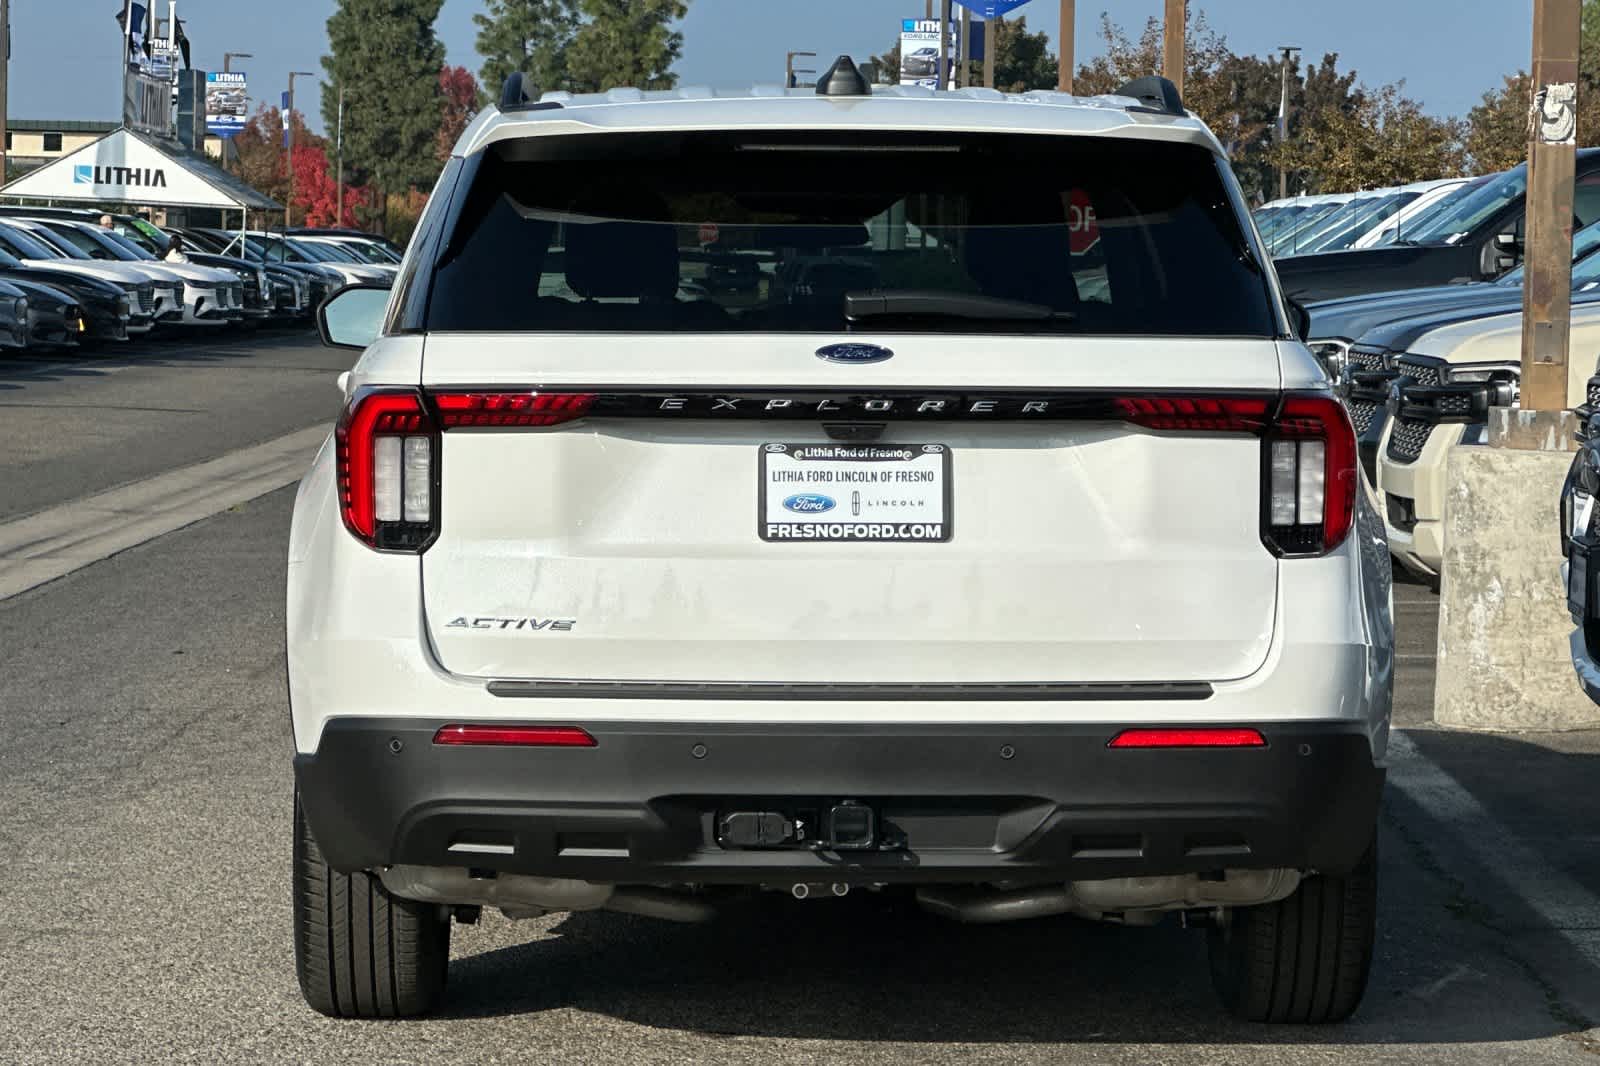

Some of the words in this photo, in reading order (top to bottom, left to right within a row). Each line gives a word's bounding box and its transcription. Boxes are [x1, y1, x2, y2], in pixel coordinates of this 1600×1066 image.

[914, 20, 941, 32] LITH
[215, 73, 245, 82] LITHIA
[94, 165, 167, 187] LITHIA
[659, 397, 1050, 414] EXPLORER
[805, 448, 833, 458] Lithia
[835, 447, 857, 458] Ford
[858, 448, 868, 458] of
[870, 448, 903, 458] Fresno
[772, 471, 804, 482] LITHIA
[807, 471, 833, 482] FORD
[835, 471, 877, 482] LINCOLN
[880, 471, 893, 482] OF
[896, 471, 934, 482] FRESNO
[793, 497, 825, 510] Ford
[767, 524, 941, 538] FRESNOFORD.COM
[444, 617, 577, 631] ACTIVE
